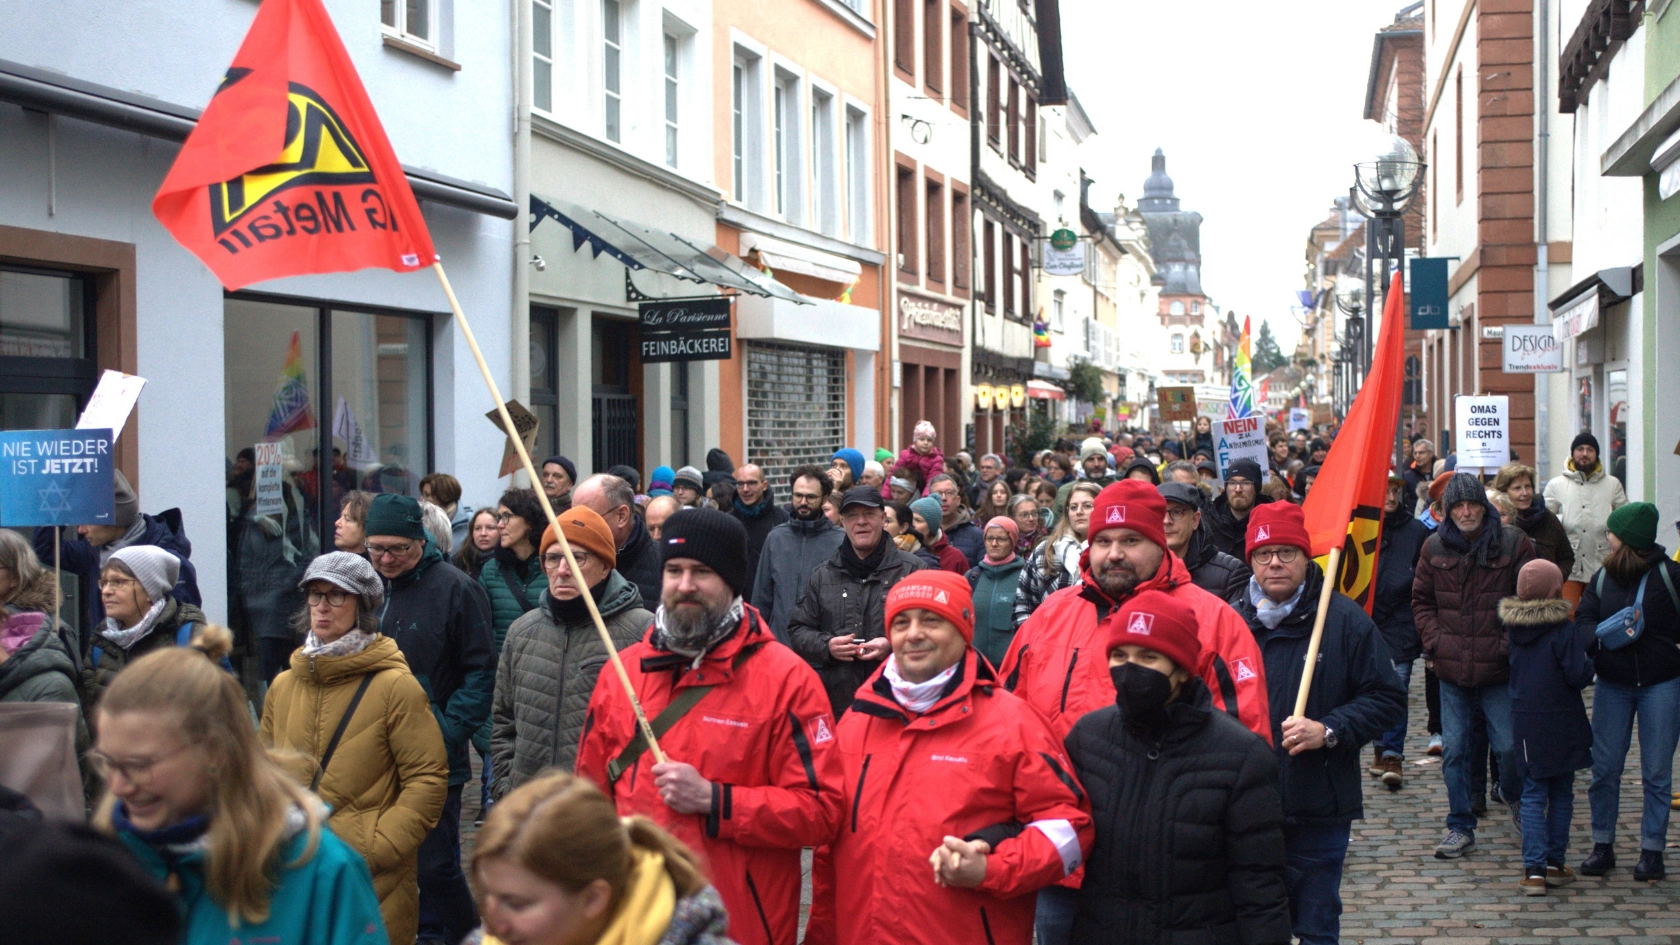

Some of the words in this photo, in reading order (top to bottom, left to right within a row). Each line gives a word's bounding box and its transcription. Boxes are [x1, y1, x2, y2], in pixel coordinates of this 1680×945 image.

[642, 309, 664, 325] La
[665, 307, 728, 324] Parisienne
[642, 337, 729, 357] FEINBÄCKEREI
[1508, 363, 1558, 371] Trendexklusiv
[1470, 405, 1497, 414] OMAS
[1223, 417, 1258, 434] NEIN
[1468, 417, 1500, 426] GEGEN
[1466, 430, 1502, 438] RECHTS
[3, 442, 31, 457] NIE
[37, 439, 108, 456] WIEDER
[257, 444, 281, 466] 20%
[13, 460, 38, 475] IST
[41, 458, 98, 475] JETZT!
